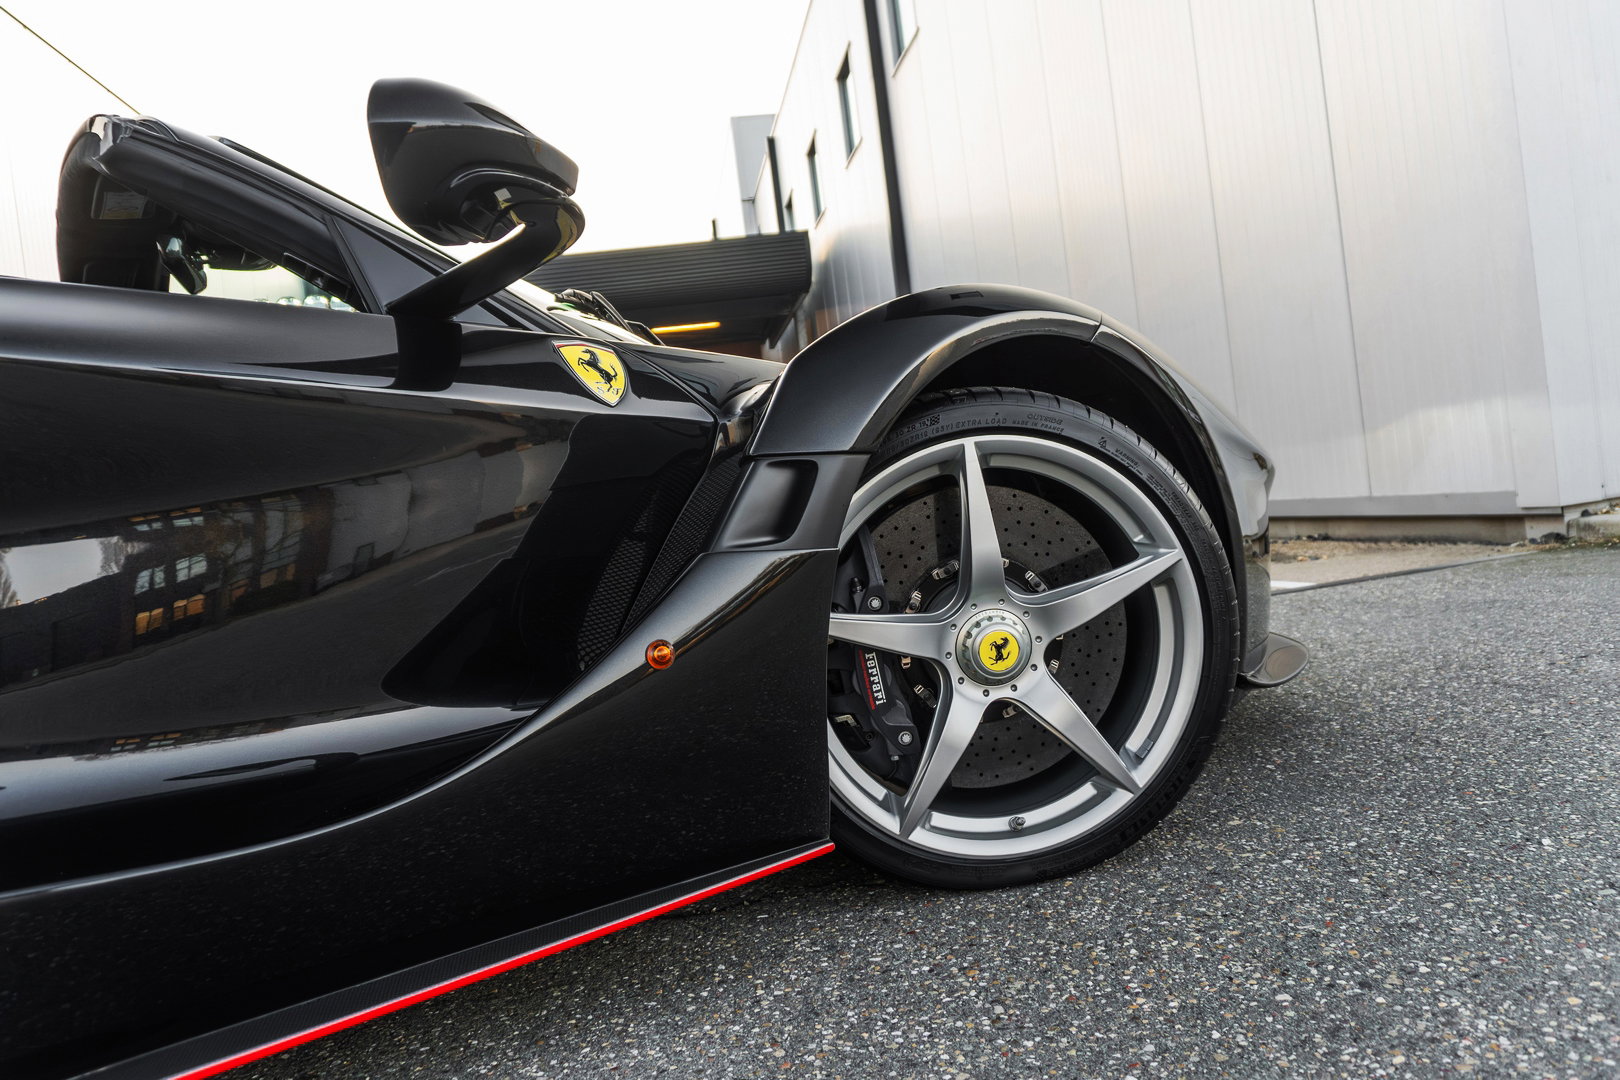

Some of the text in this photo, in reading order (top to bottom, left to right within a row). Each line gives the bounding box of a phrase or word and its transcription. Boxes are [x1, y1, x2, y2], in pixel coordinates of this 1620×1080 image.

[954, 417, 982, 428] EXTRA
[984, 416, 1007, 424] LOAD
[1040, 422, 1064, 433] FRANCE
[865, 652, 887, 705] Ferrari
